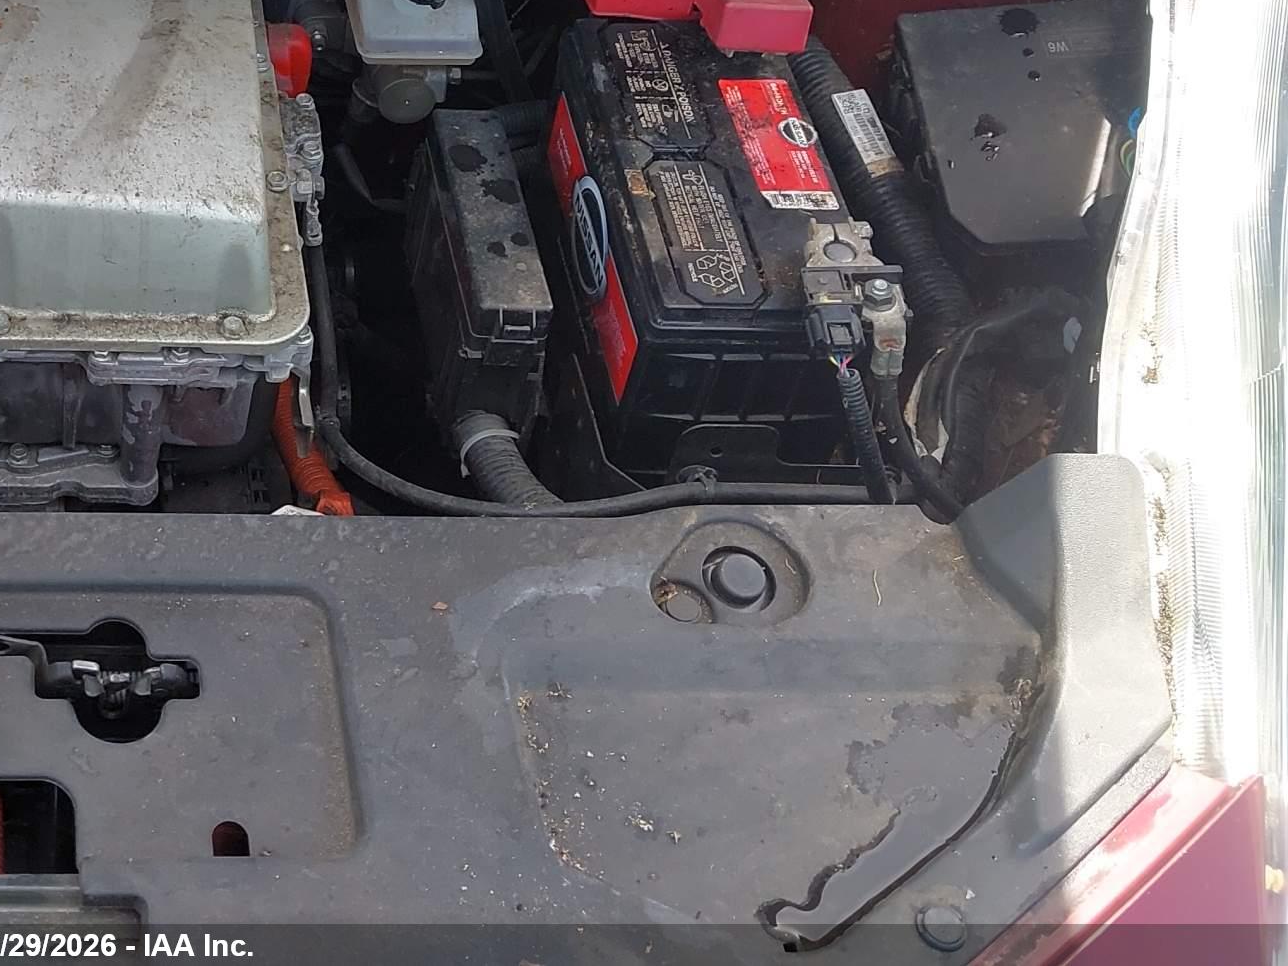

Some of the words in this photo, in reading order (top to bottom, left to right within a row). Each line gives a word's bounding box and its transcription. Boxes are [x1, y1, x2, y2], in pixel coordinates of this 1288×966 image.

[677, 91, 695, 122] POISON
[790, 119, 807, 146] NISSAN
[574, 192, 603, 288] NISSAN
